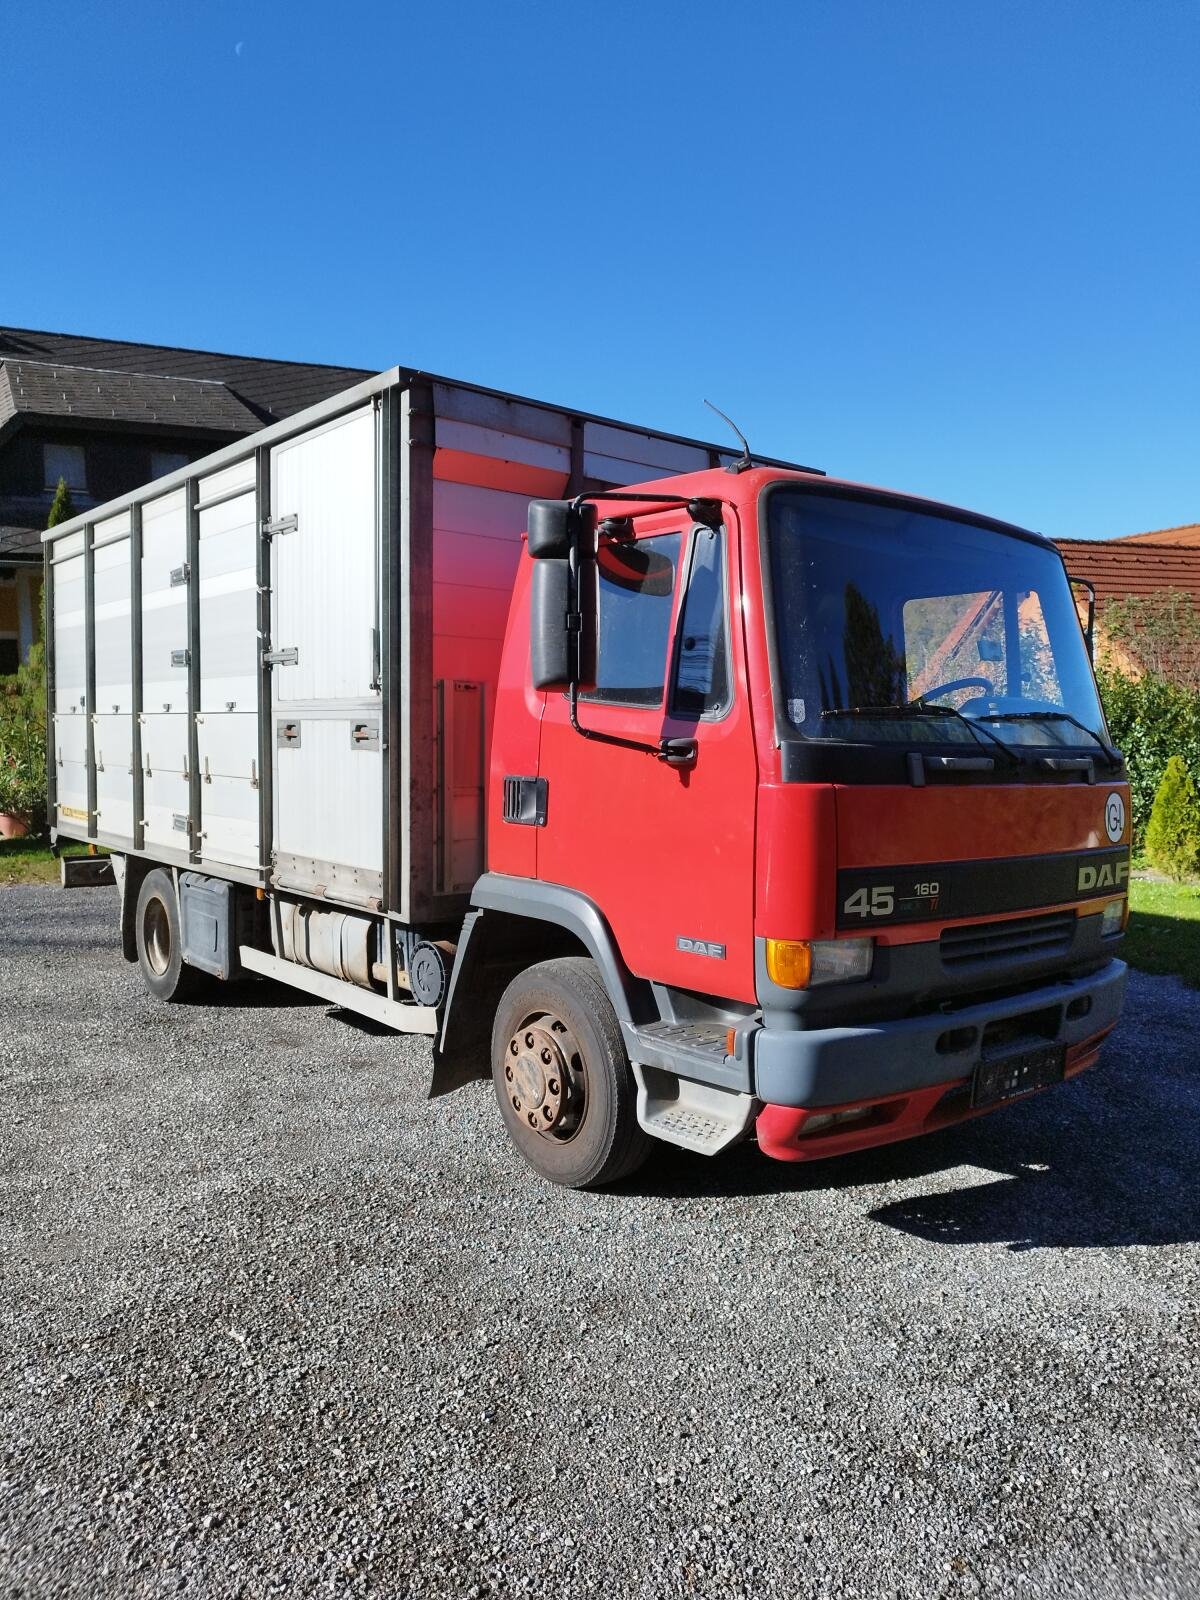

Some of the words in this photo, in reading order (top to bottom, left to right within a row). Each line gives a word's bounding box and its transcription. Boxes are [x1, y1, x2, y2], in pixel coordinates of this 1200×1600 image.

[1078, 861, 1128, 891] DAF
[914, 882, 939, 895] 160
[844, 886, 895, 917] 45
[679, 938, 722, 955] DAF
